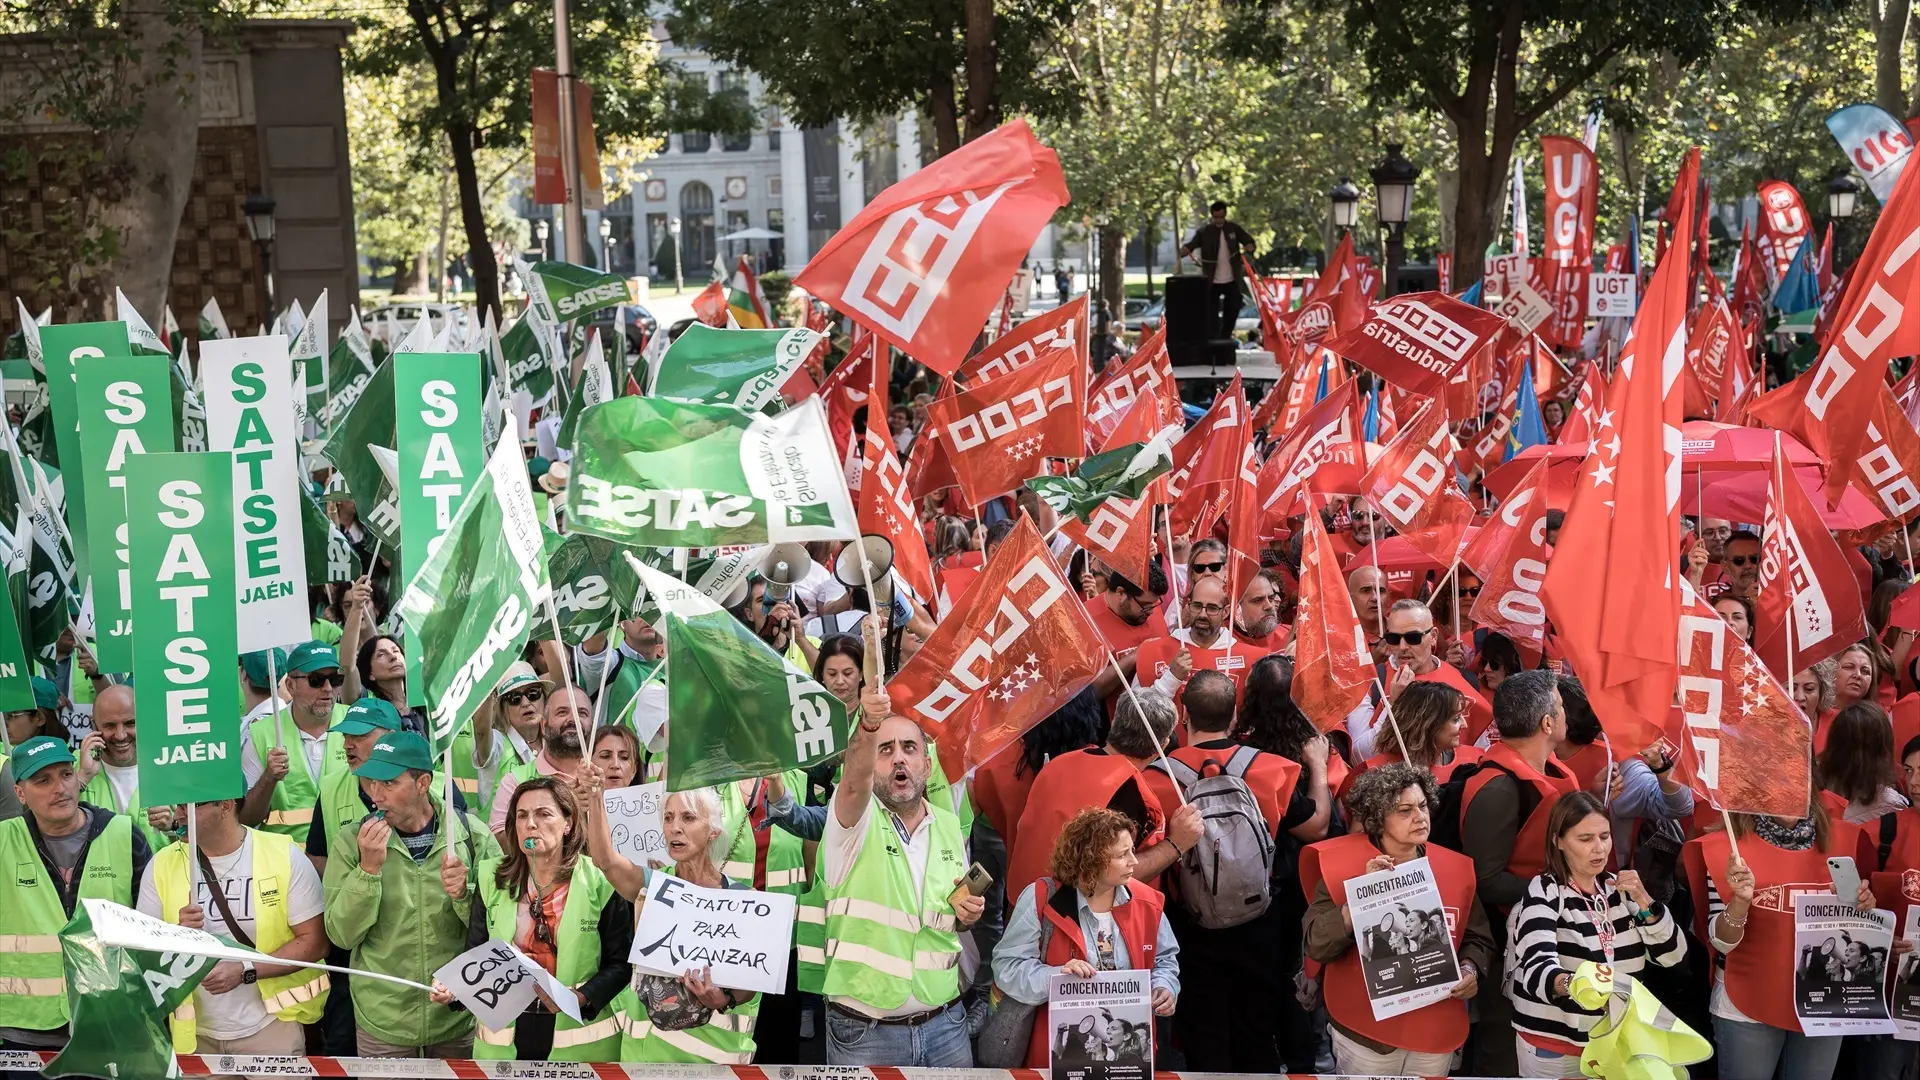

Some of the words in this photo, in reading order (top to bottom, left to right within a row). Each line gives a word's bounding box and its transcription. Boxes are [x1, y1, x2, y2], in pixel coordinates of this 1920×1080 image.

[1552, 153, 1582, 267] UGT
[1484, 257, 1519, 276] UGT
[1596, 278, 1628, 294] UGT
[558, 282, 627, 317] SATSE
[230, 362, 281, 579] SATSE
[240, 580, 293, 604] JAÉN
[156, 480, 211, 737] SATSE
[154, 741, 227, 765] JAÉN
[1357, 870, 1426, 899] CONCENTRACIÓN
[653, 878, 771, 917] ESTATUTO
[1805, 905, 1884, 925] CONCENTRACIÓN
[693, 920, 741, 939] PARA
[640, 924, 770, 976] AVANZAR
[1060, 979, 1140, 995] CONCENTRACIÓN
[236, 1065, 261, 1073] LINEA
[279, 1066, 312, 1074] POLICIA
[514, 1070, 540, 1078] LINEA
[544, 1070, 557, 1078] DE
[560, 1071, 595, 1079] POLICIA
